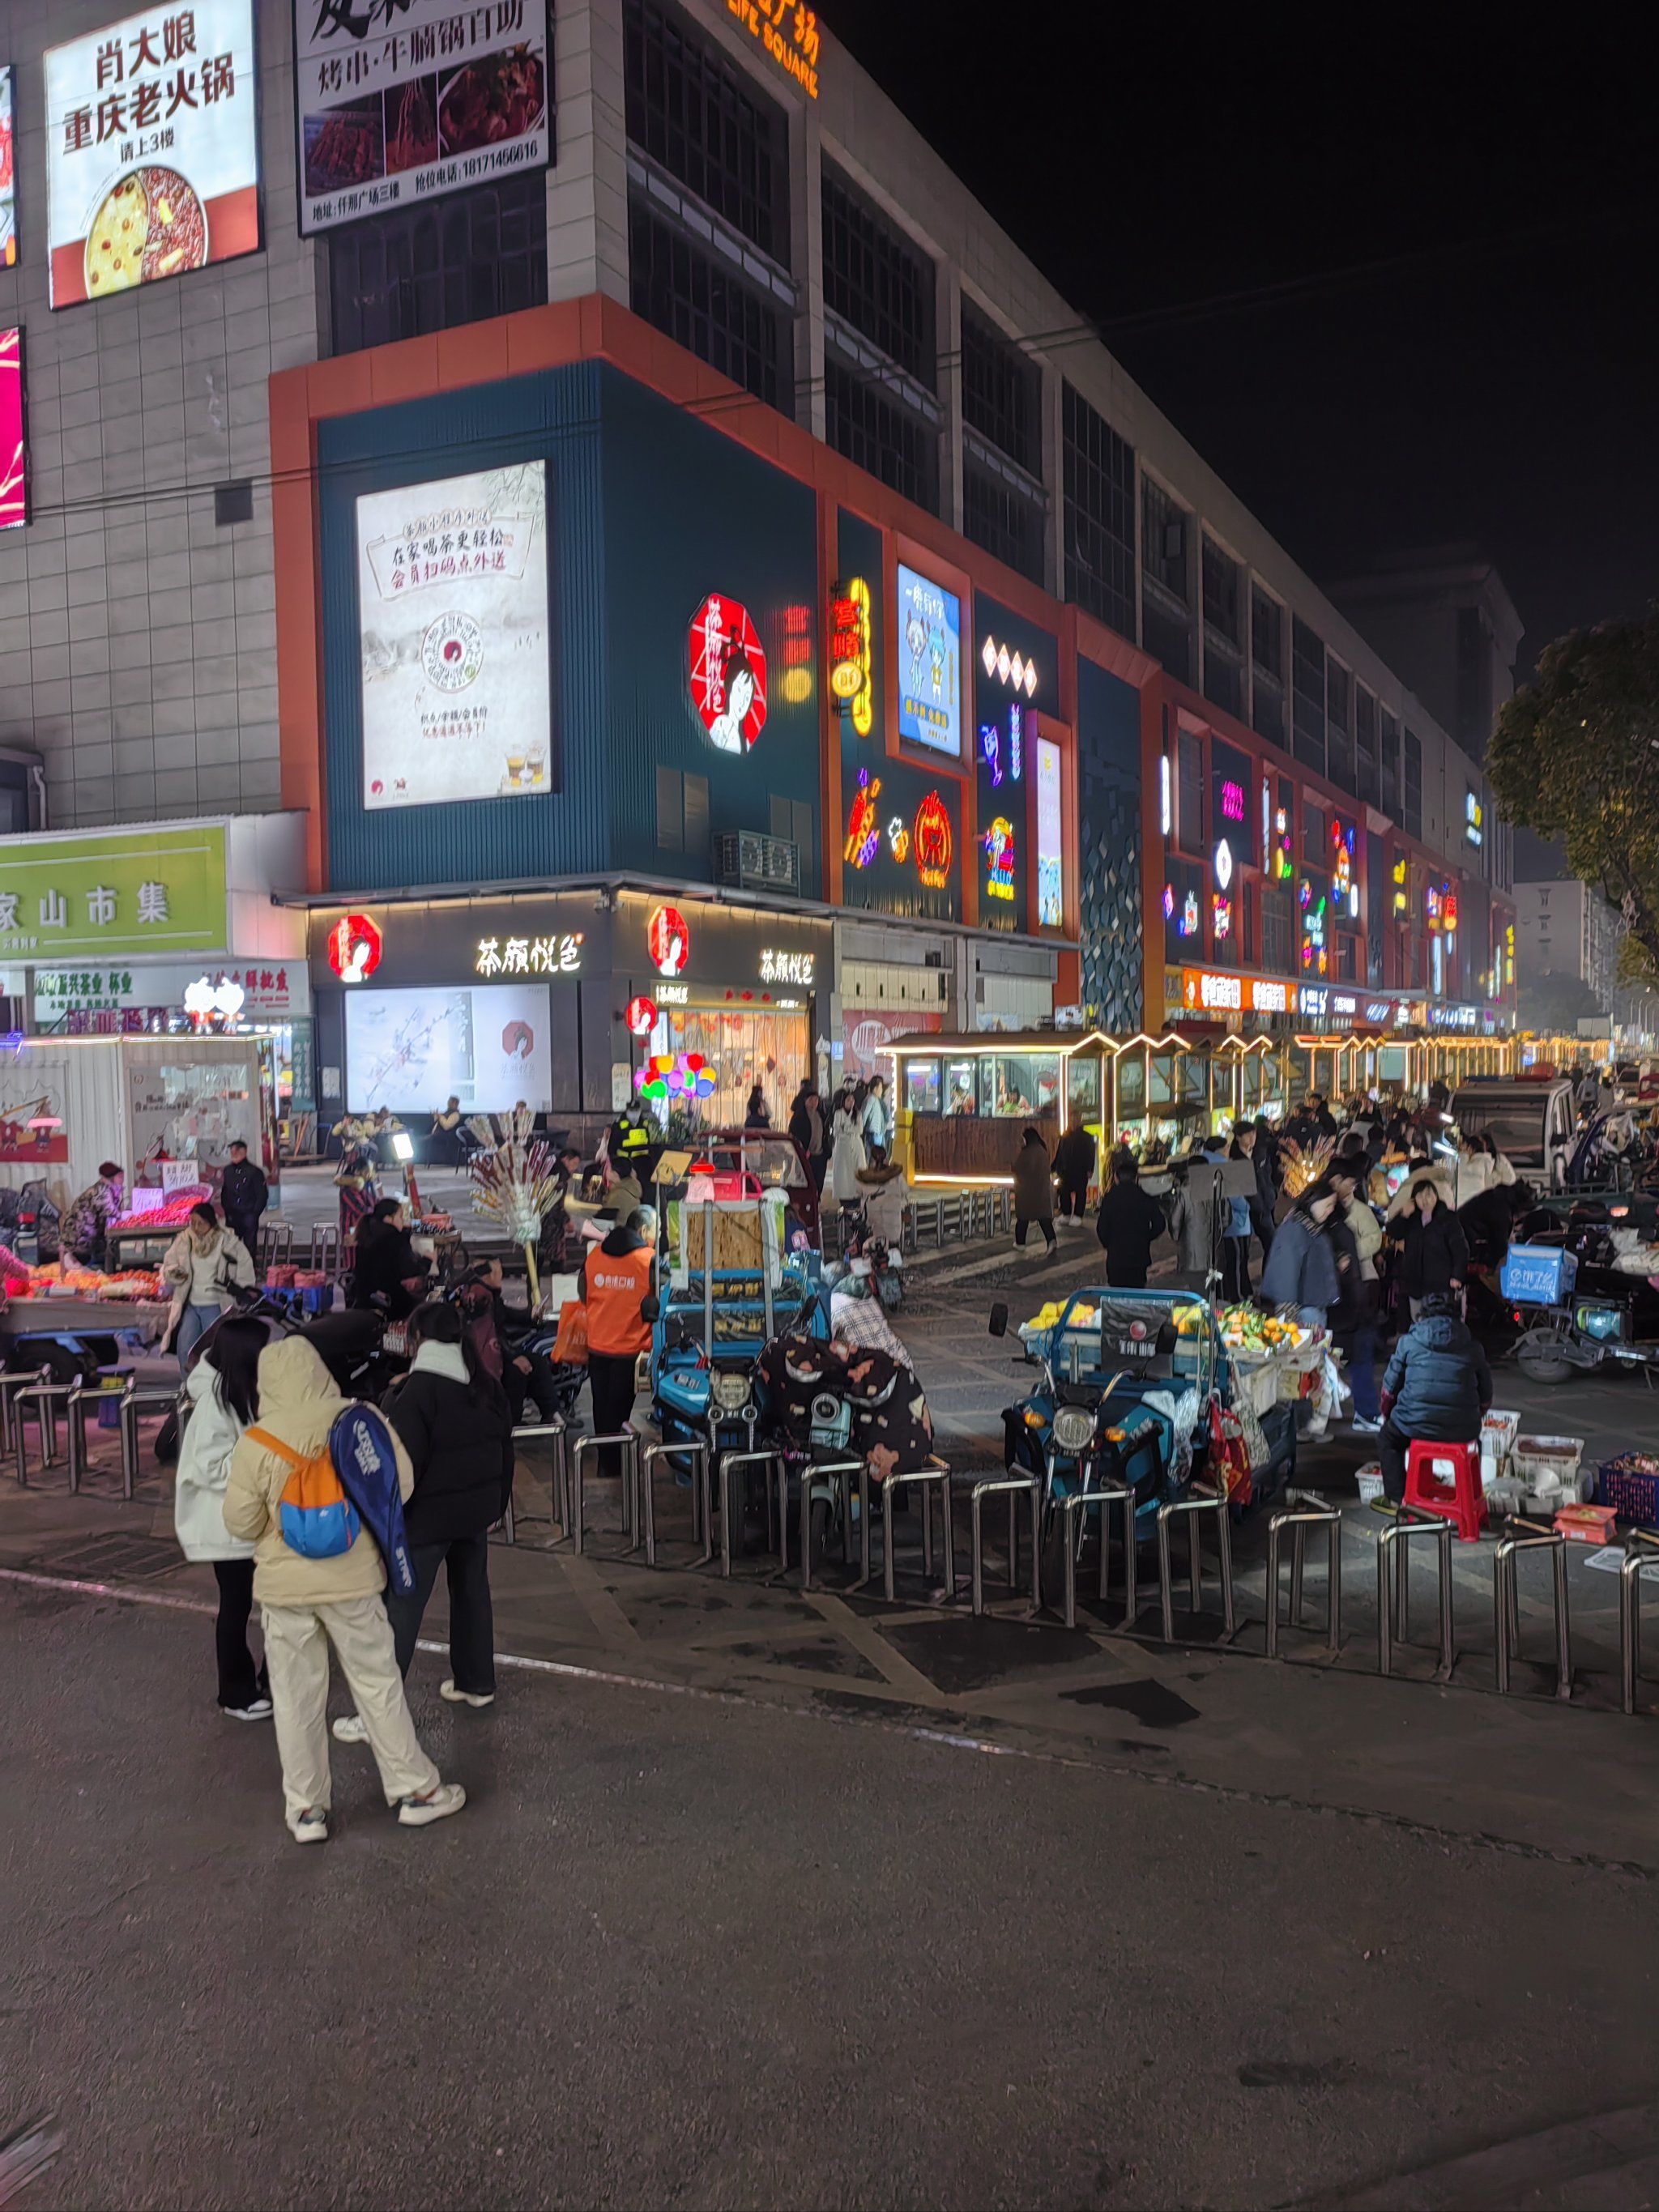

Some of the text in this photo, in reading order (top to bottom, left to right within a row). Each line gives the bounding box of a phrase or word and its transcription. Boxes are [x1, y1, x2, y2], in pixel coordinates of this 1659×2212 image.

[96, 10, 197, 88] 肖大娘
[763, 22, 818, 99] SQUARE
[62, 53, 235, 156] 重庆老火锅
[120, 126, 176, 162] 请上3楼
[393, 526, 504, 566] 在家喝茶更轻松
[391, 550, 506, 589] 会员扫码点外送
[476, 935, 581, 978] 茶颜悦色
[759, 949, 813, 985] 茶颜悦色
